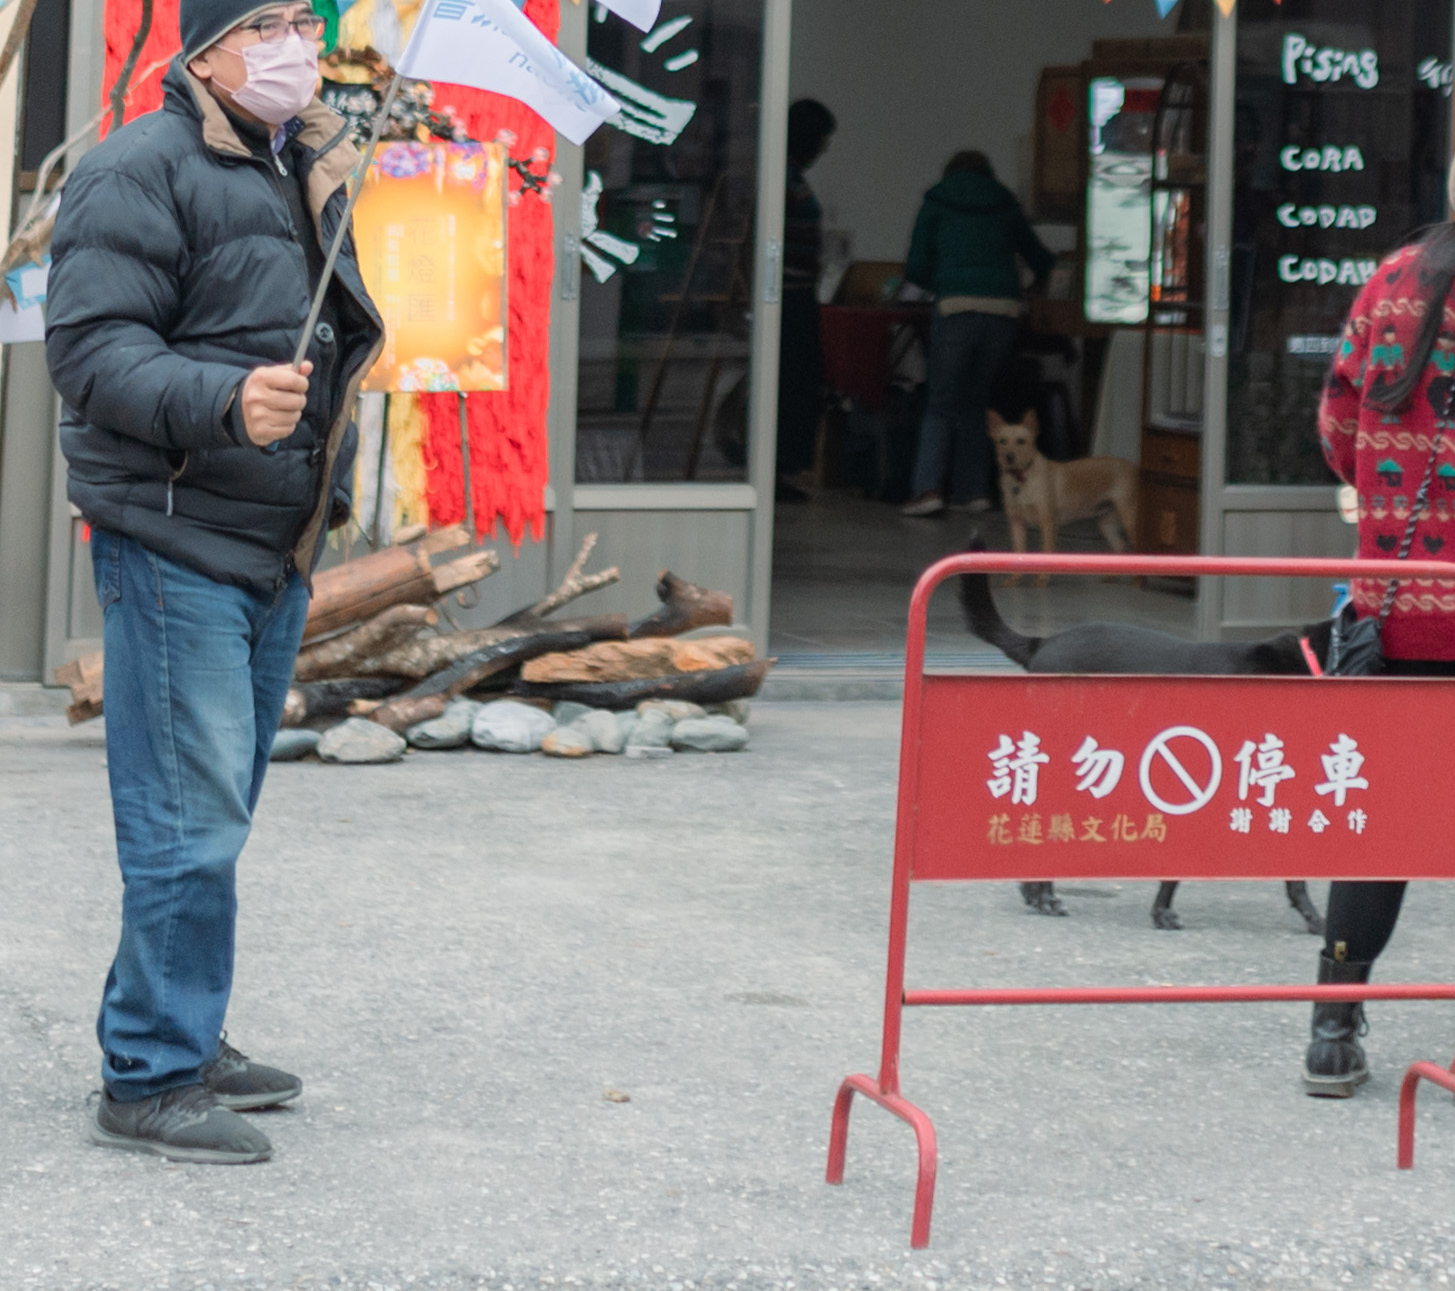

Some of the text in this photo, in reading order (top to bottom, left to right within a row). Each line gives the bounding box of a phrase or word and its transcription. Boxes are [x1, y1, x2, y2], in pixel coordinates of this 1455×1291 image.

[1281, 32, 1380, 90] Pising
[986, 812, 1168, 847] 花蓮縣文化局
[1228, 807, 1369, 836] 謝謝合作
